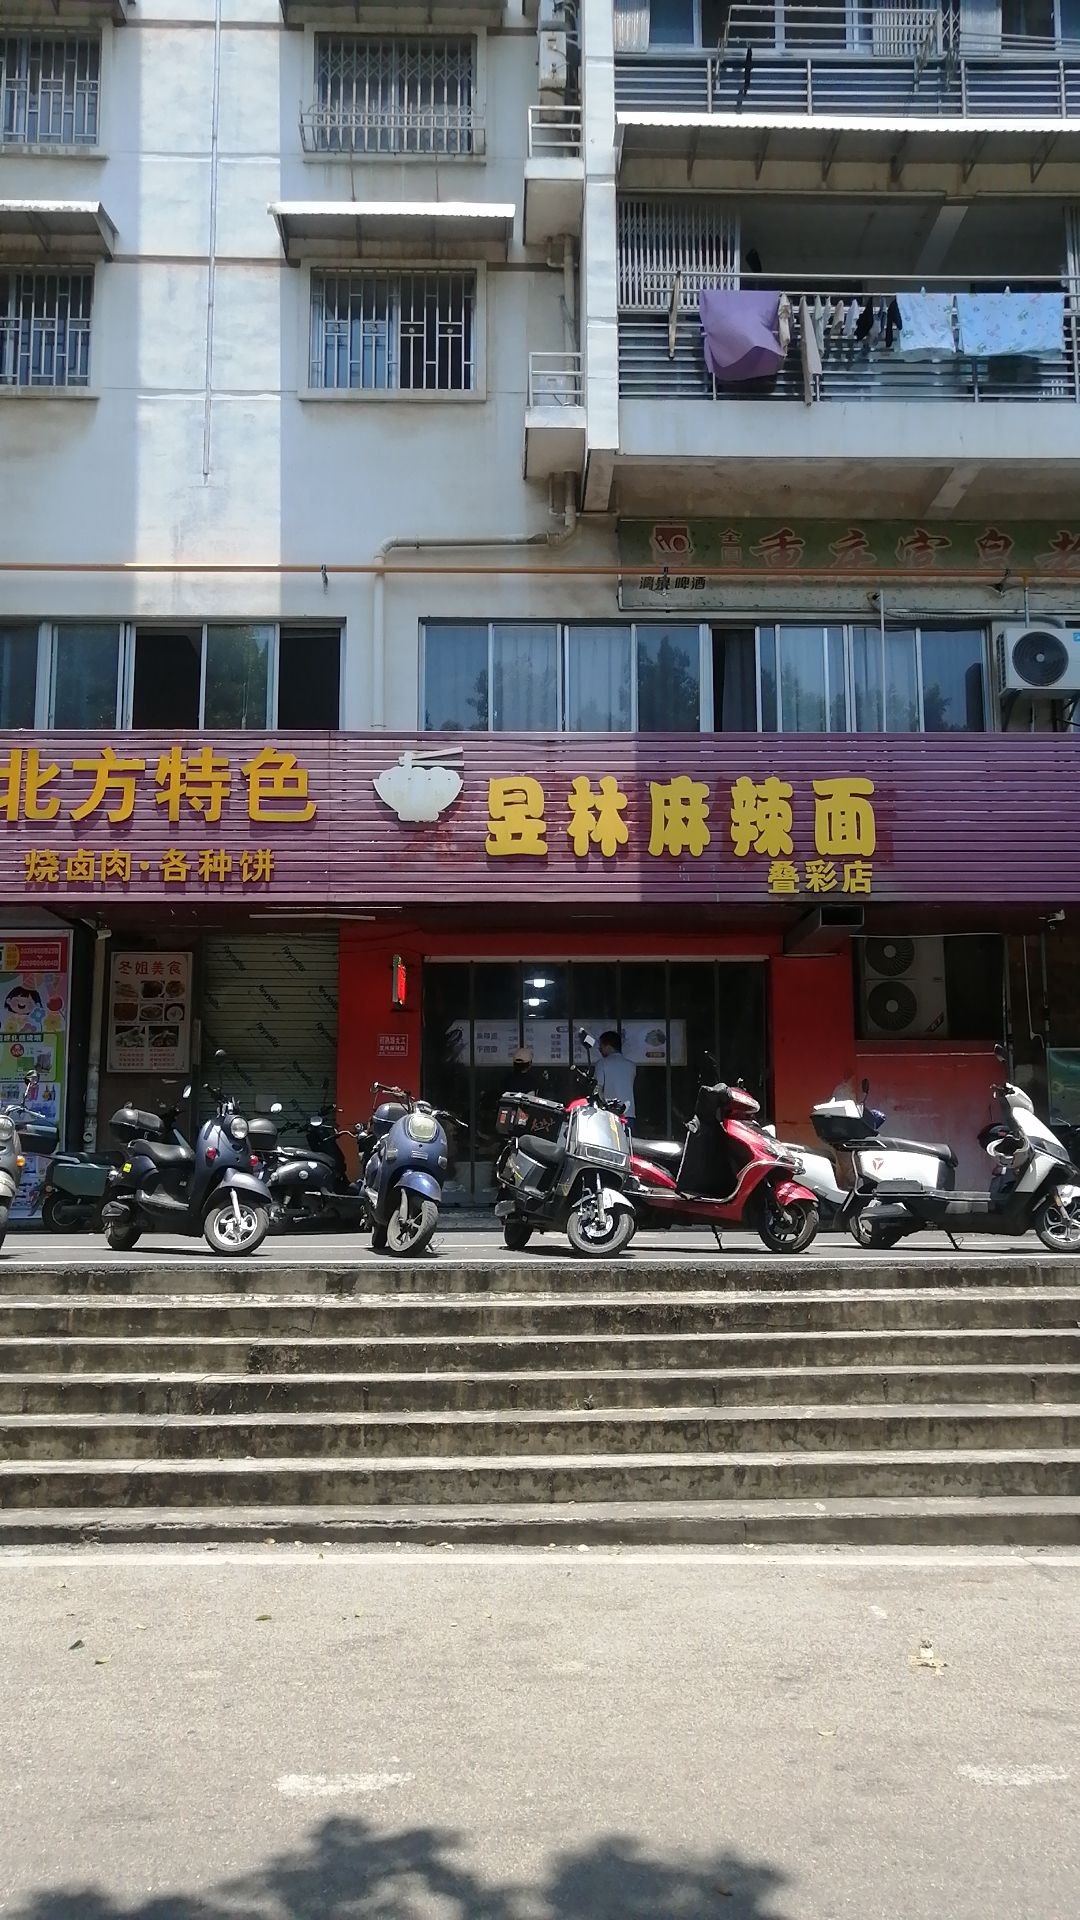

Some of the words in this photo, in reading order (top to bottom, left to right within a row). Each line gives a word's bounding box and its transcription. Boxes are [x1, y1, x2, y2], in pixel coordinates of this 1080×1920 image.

[0, 745, 318, 823] 北方特色
[485, 775, 877, 858] 昱林麻辣面
[767, 859, 873, 895] 叠彩店
[118, 960, 183, 976] 冬姐美食
